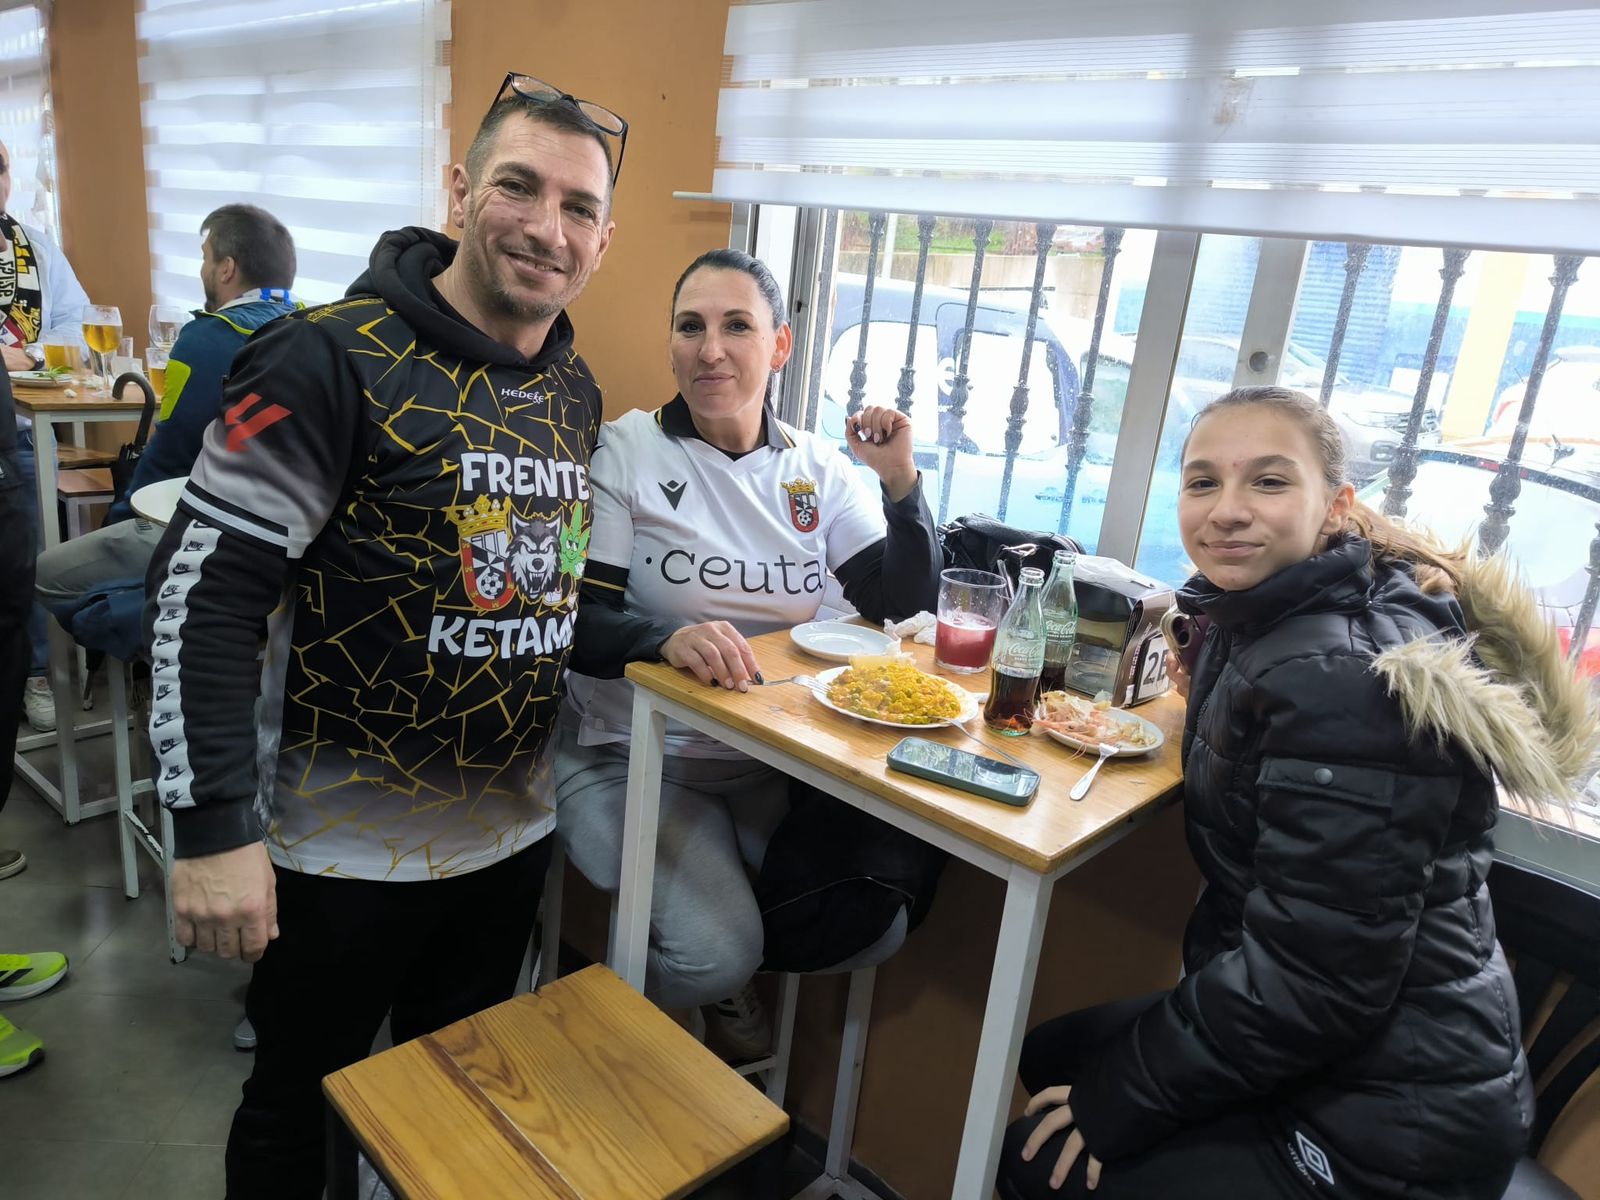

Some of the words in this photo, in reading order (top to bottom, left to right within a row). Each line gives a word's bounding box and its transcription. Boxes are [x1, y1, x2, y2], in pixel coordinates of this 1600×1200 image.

[461, 452, 589, 500] FRENTE
[660, 549, 824, 595] ceuta
[427, 610, 577, 660] KETAM
